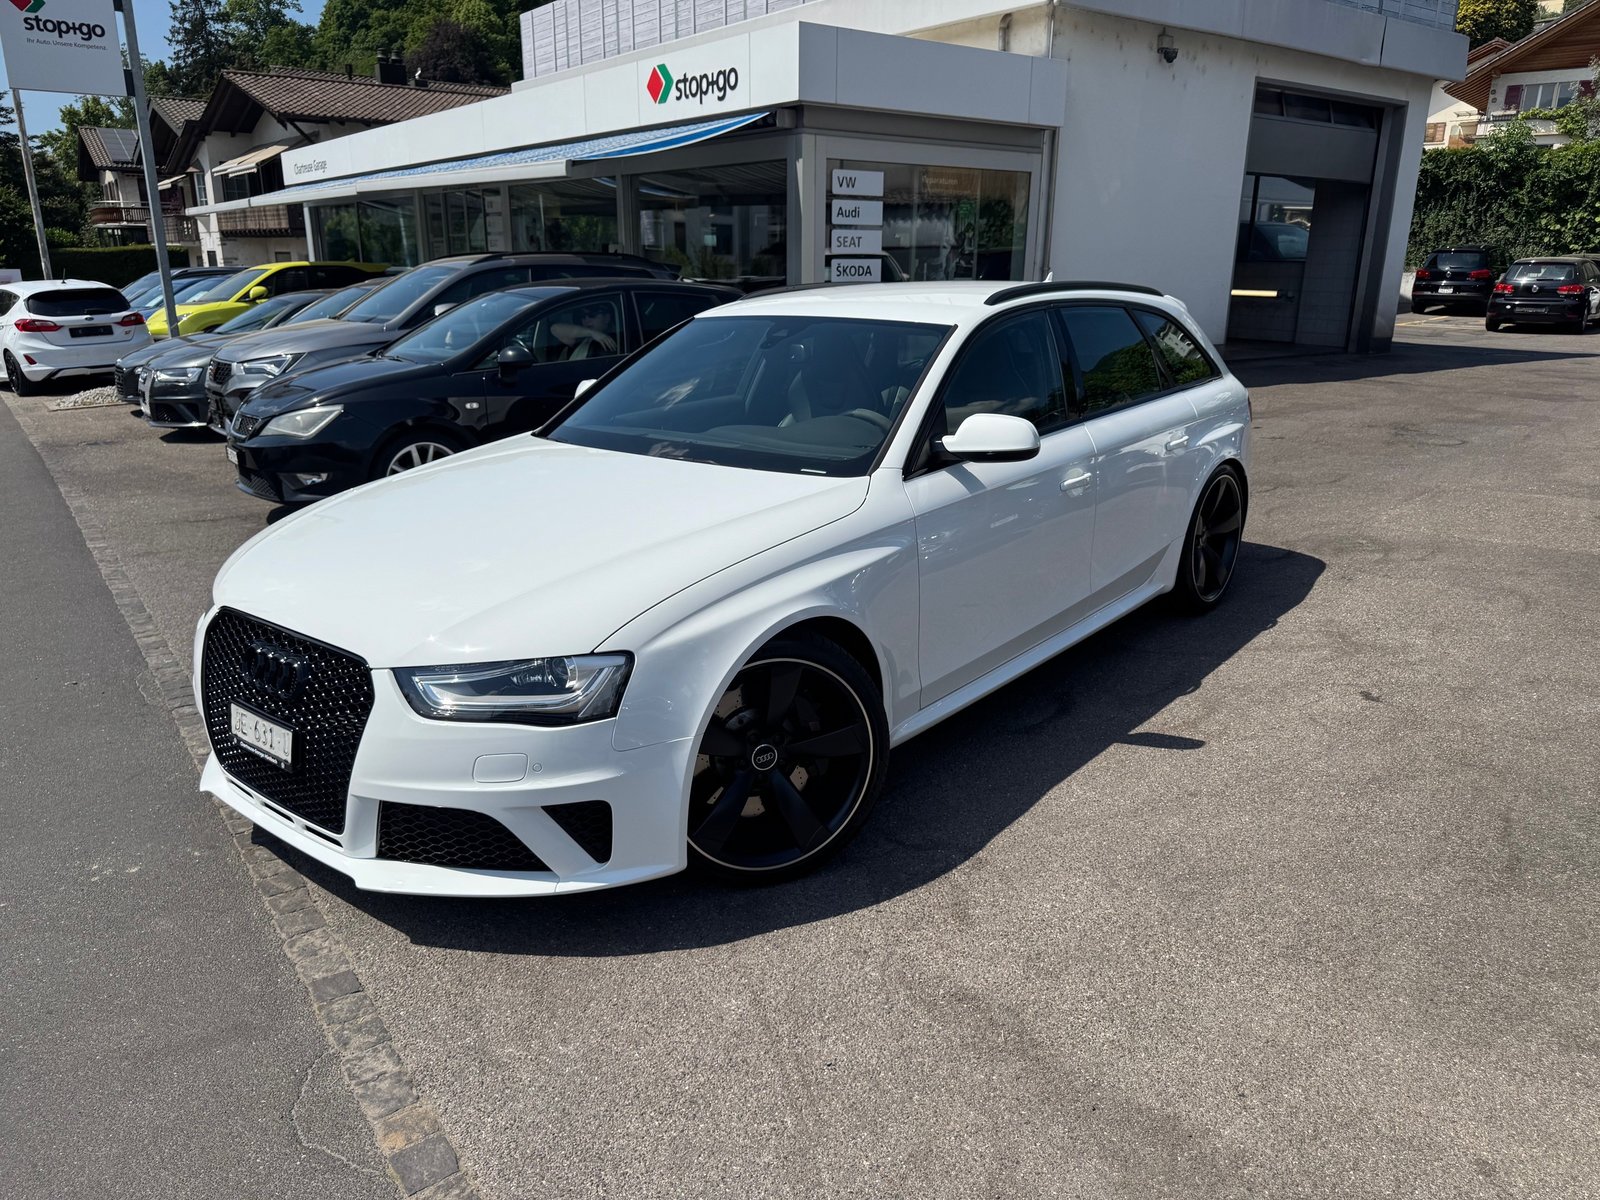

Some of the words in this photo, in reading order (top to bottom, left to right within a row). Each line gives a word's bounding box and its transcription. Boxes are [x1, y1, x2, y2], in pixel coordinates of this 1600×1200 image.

[23, 15, 106, 41] stop+go
[53, 40, 74, 48] Unsere
[675, 67, 739, 105] stop+go
[837, 176, 857, 189] VW
[836, 206, 860, 219] Audi
[836, 235, 862, 248] SEAT
[836, 262, 873, 277] ŠKODA
